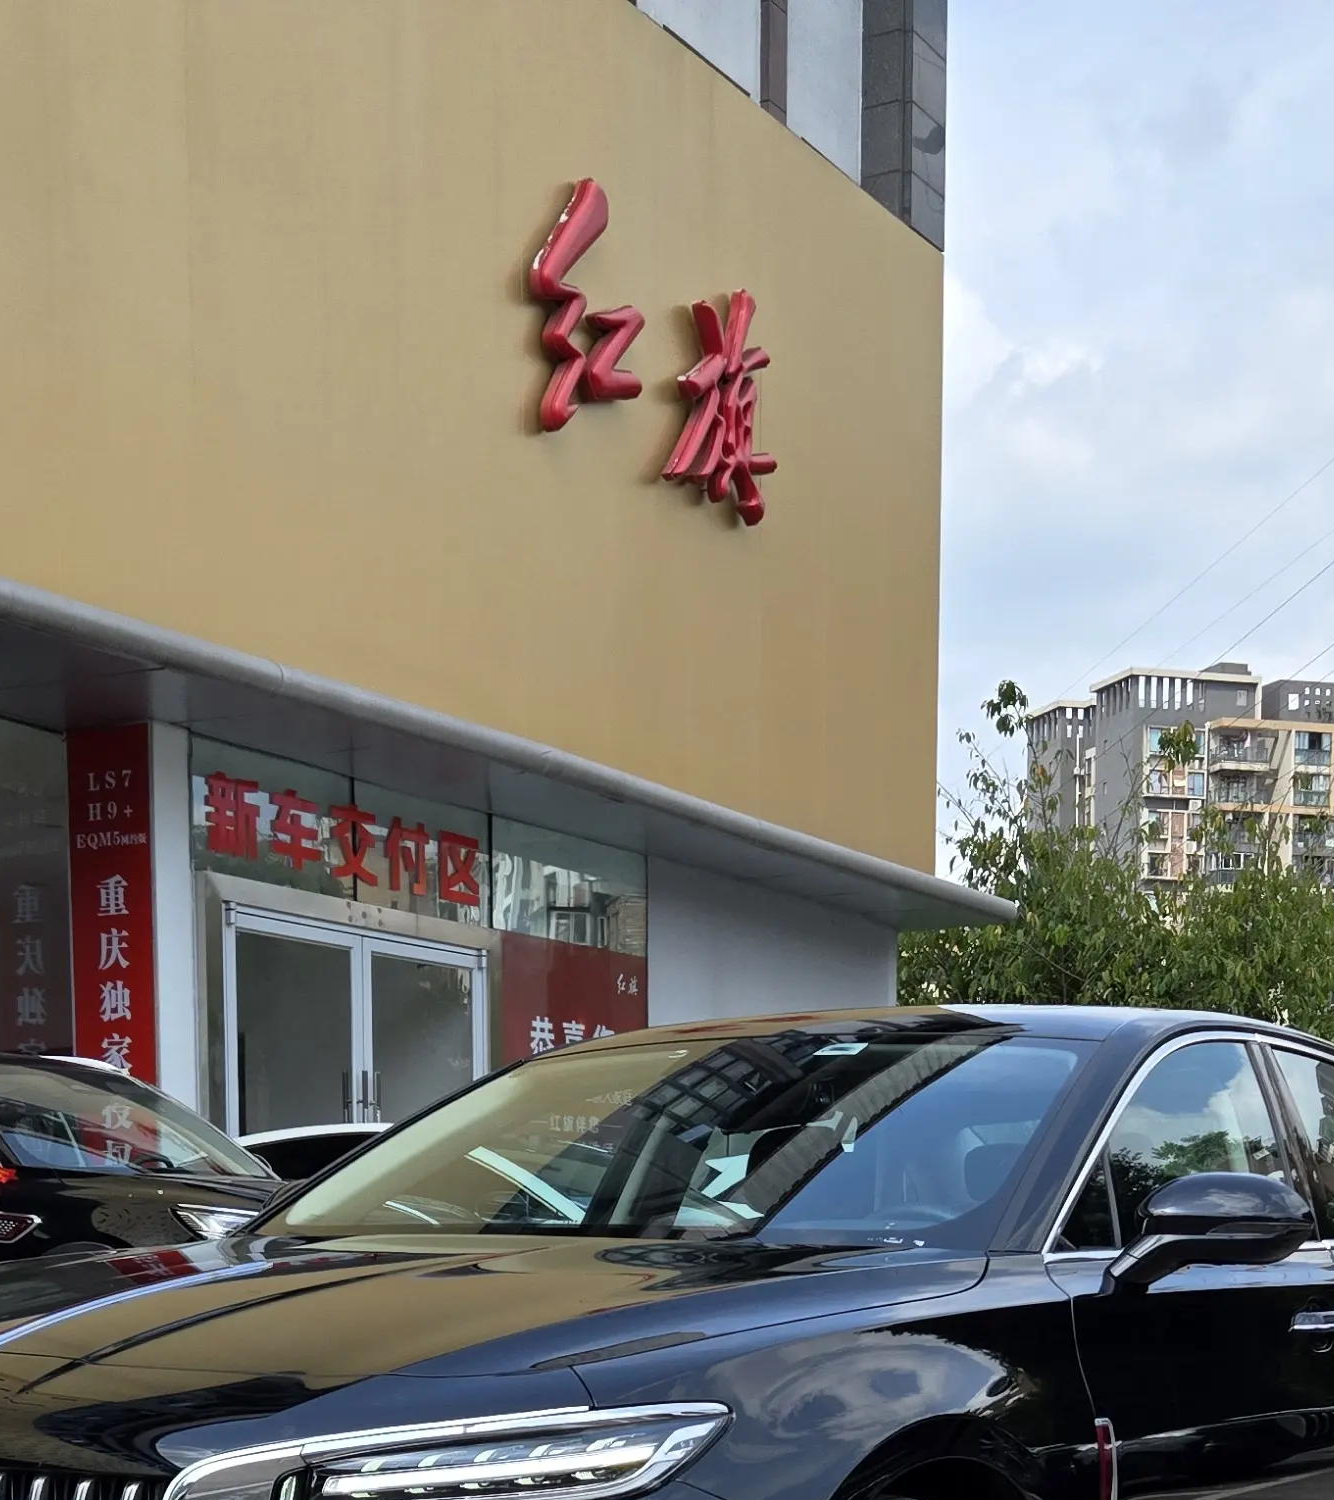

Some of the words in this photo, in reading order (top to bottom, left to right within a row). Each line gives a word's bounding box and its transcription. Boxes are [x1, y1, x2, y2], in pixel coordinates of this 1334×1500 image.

[529, 177, 778, 526] 红旗
[205, 771, 480, 907] 新车交付区
